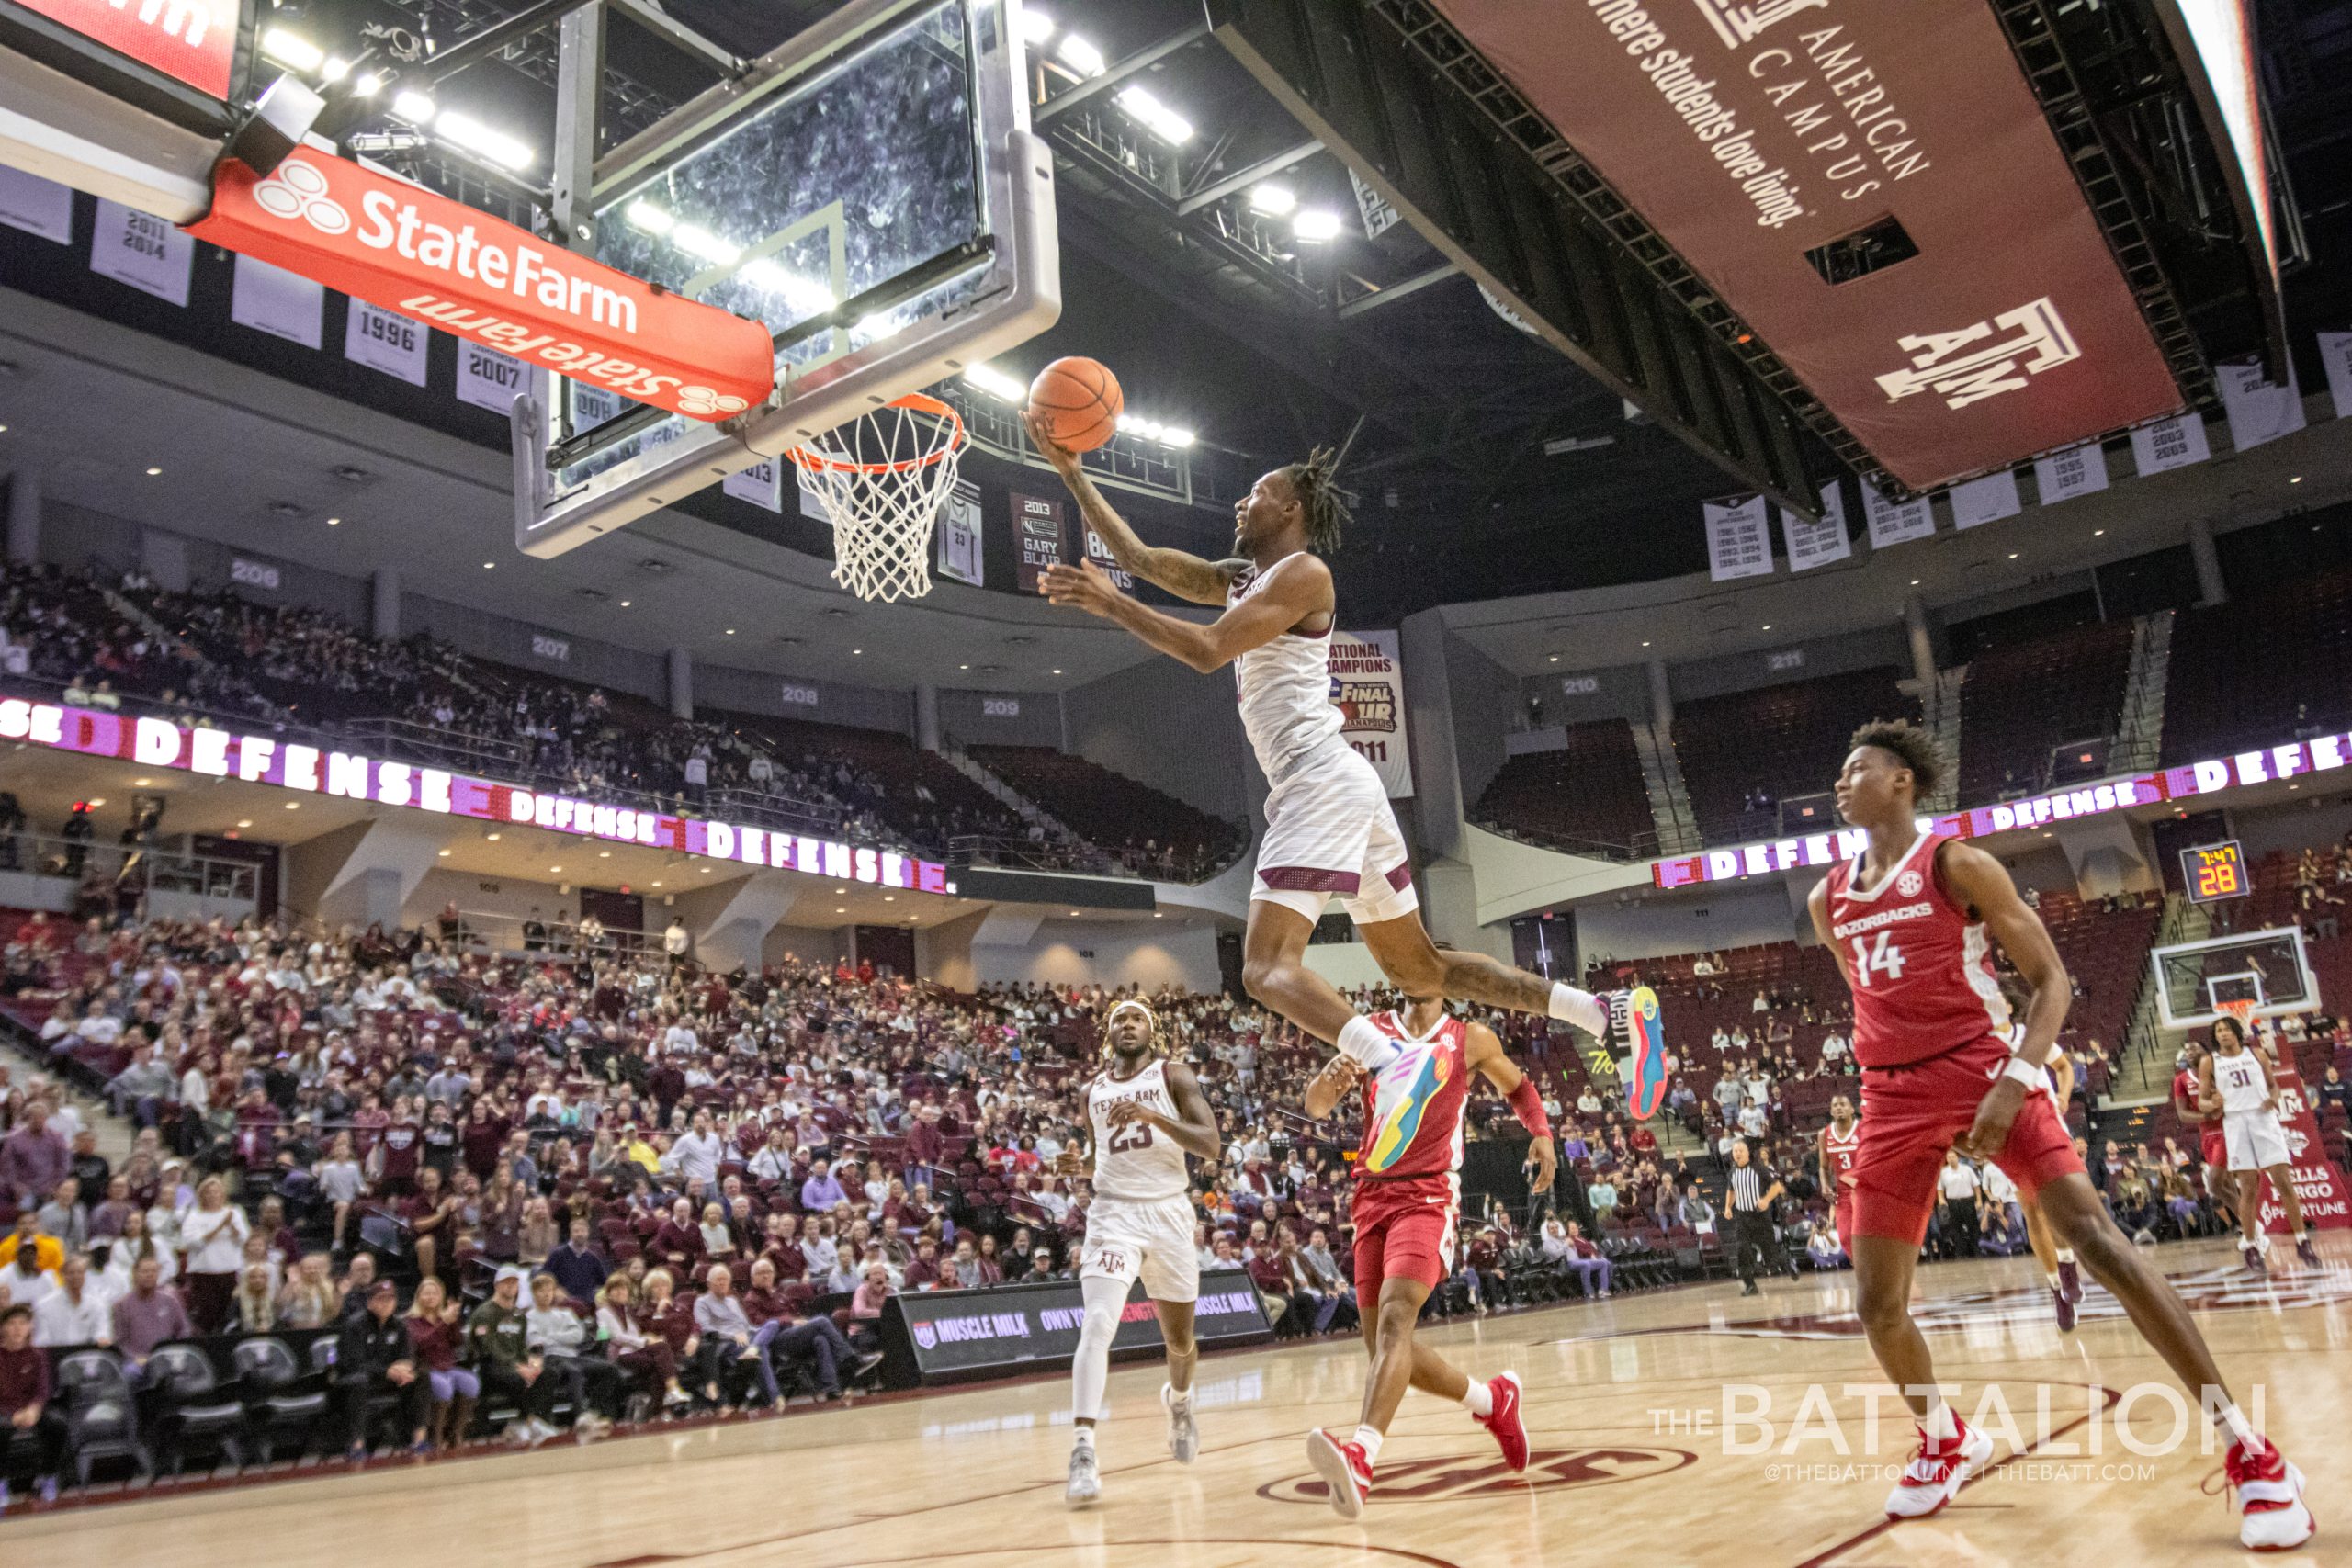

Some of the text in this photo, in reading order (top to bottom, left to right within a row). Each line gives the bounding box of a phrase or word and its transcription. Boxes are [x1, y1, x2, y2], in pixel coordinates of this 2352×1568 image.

[1799, 24, 1930, 181] AMERICAN
[1640, 49, 1735, 141] students
[1712, 129, 1766, 179] love
[1748, 49, 1881, 200] CAMPUS
[127, 211, 165, 240] 2011
[122, 231, 165, 261] 2014
[360, 310, 415, 352] 1996
[469, 353, 520, 389] 2007
[2153, 429, 2184, 447] 2003
[2155, 442, 2188, 460] 2009
[741, 462, 772, 484] 013
[1023, 501, 1050, 515] 2013
[1023, 537, 1057, 554] GARY
[1023, 551, 1061, 567] BLAIR
[232, 559, 278, 588] 206
[532, 637, 569, 660] 207
[1329, 643, 1382, 658] ATIONAL
[1328, 659, 1392, 673] AMPIONS
[783, 686, 817, 705] 208
[1341, 683, 1391, 702] FINAL
[1565, 679, 1597, 694] 210
[984, 700, 1019, 716] 209
[1351, 740, 1387, 761] 011
[134, 716, 451, 813] DEFENSE
[2193, 731, 2352, 794] DEFE
[510, 790, 655, 843] DEFENSE
[1992, 782, 2137, 830] DEFENSE
[707, 820, 903, 887] DEFENSE
[2199, 846, 2237, 866] 7:47
[2199, 863, 2237, 897] 28
[1851, 931, 1906, 987] 14
[2230, 1069, 2252, 1089] 31
[1135, 1089, 1160, 1101] A&M
[1839, 1154, 1851, 1169] 3
[2270, 1182, 2334, 1202] FRGO
[1227, 1292, 1257, 1313] MILK
[934, 1314, 993, 1343] MUSCLE
[991, 1311, 1029, 1337] MILK
[1040, 1308, 1071, 1331] OWN
